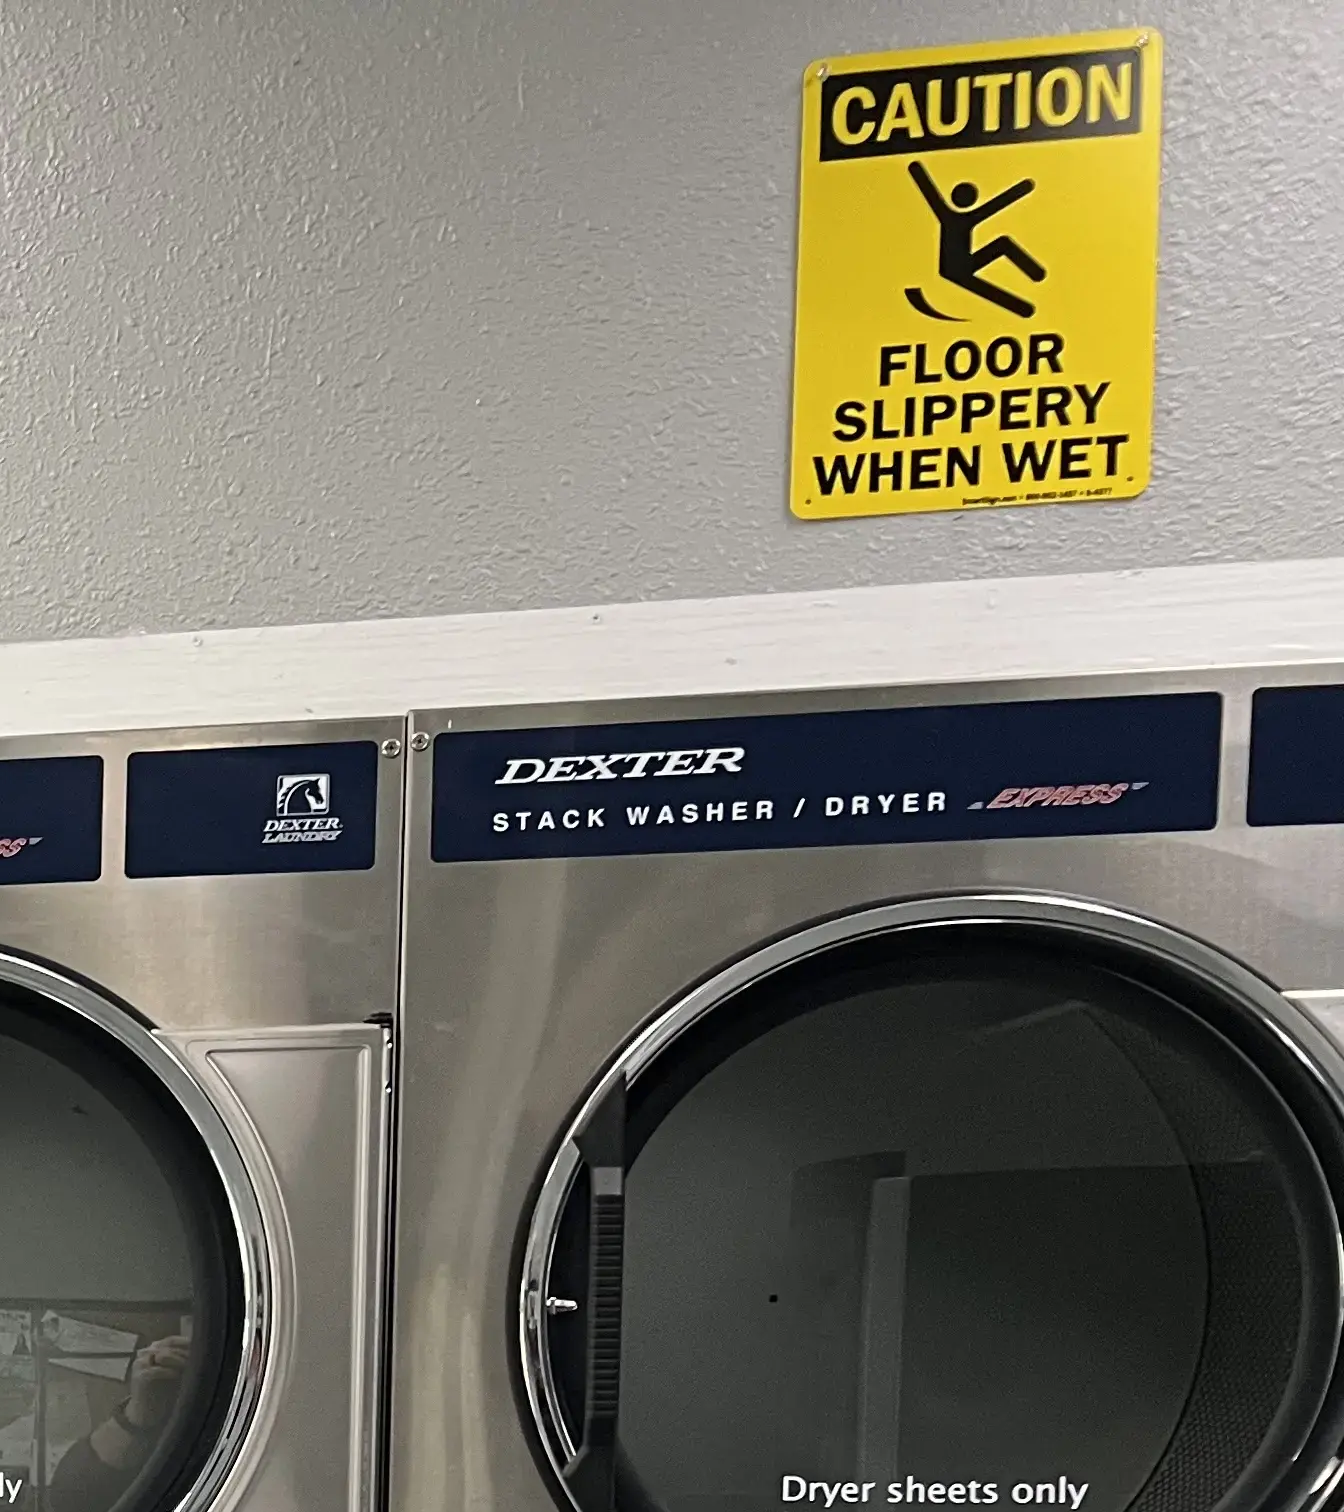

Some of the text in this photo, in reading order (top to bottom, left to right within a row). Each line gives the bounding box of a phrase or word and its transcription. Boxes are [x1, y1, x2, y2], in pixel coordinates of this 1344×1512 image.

[830, 63, 1133, 146] CAUTION
[879, 334, 1064, 387] FLOOR
[832, 382, 1110, 443] SLIPPERY
[812, 434, 1130, 495] WHEN WET
[493, 747, 747, 786] DEXTER
[263, 817, 343, 832] DEXTER
[492, 805, 605, 833] STACK
[625, 798, 776, 825] WASHER
[825, 791, 949, 817] DRYER
[986, 782, 1133, 810] EXPRESS
[782, 1474, 1088, 1510] Dryer sheets only
